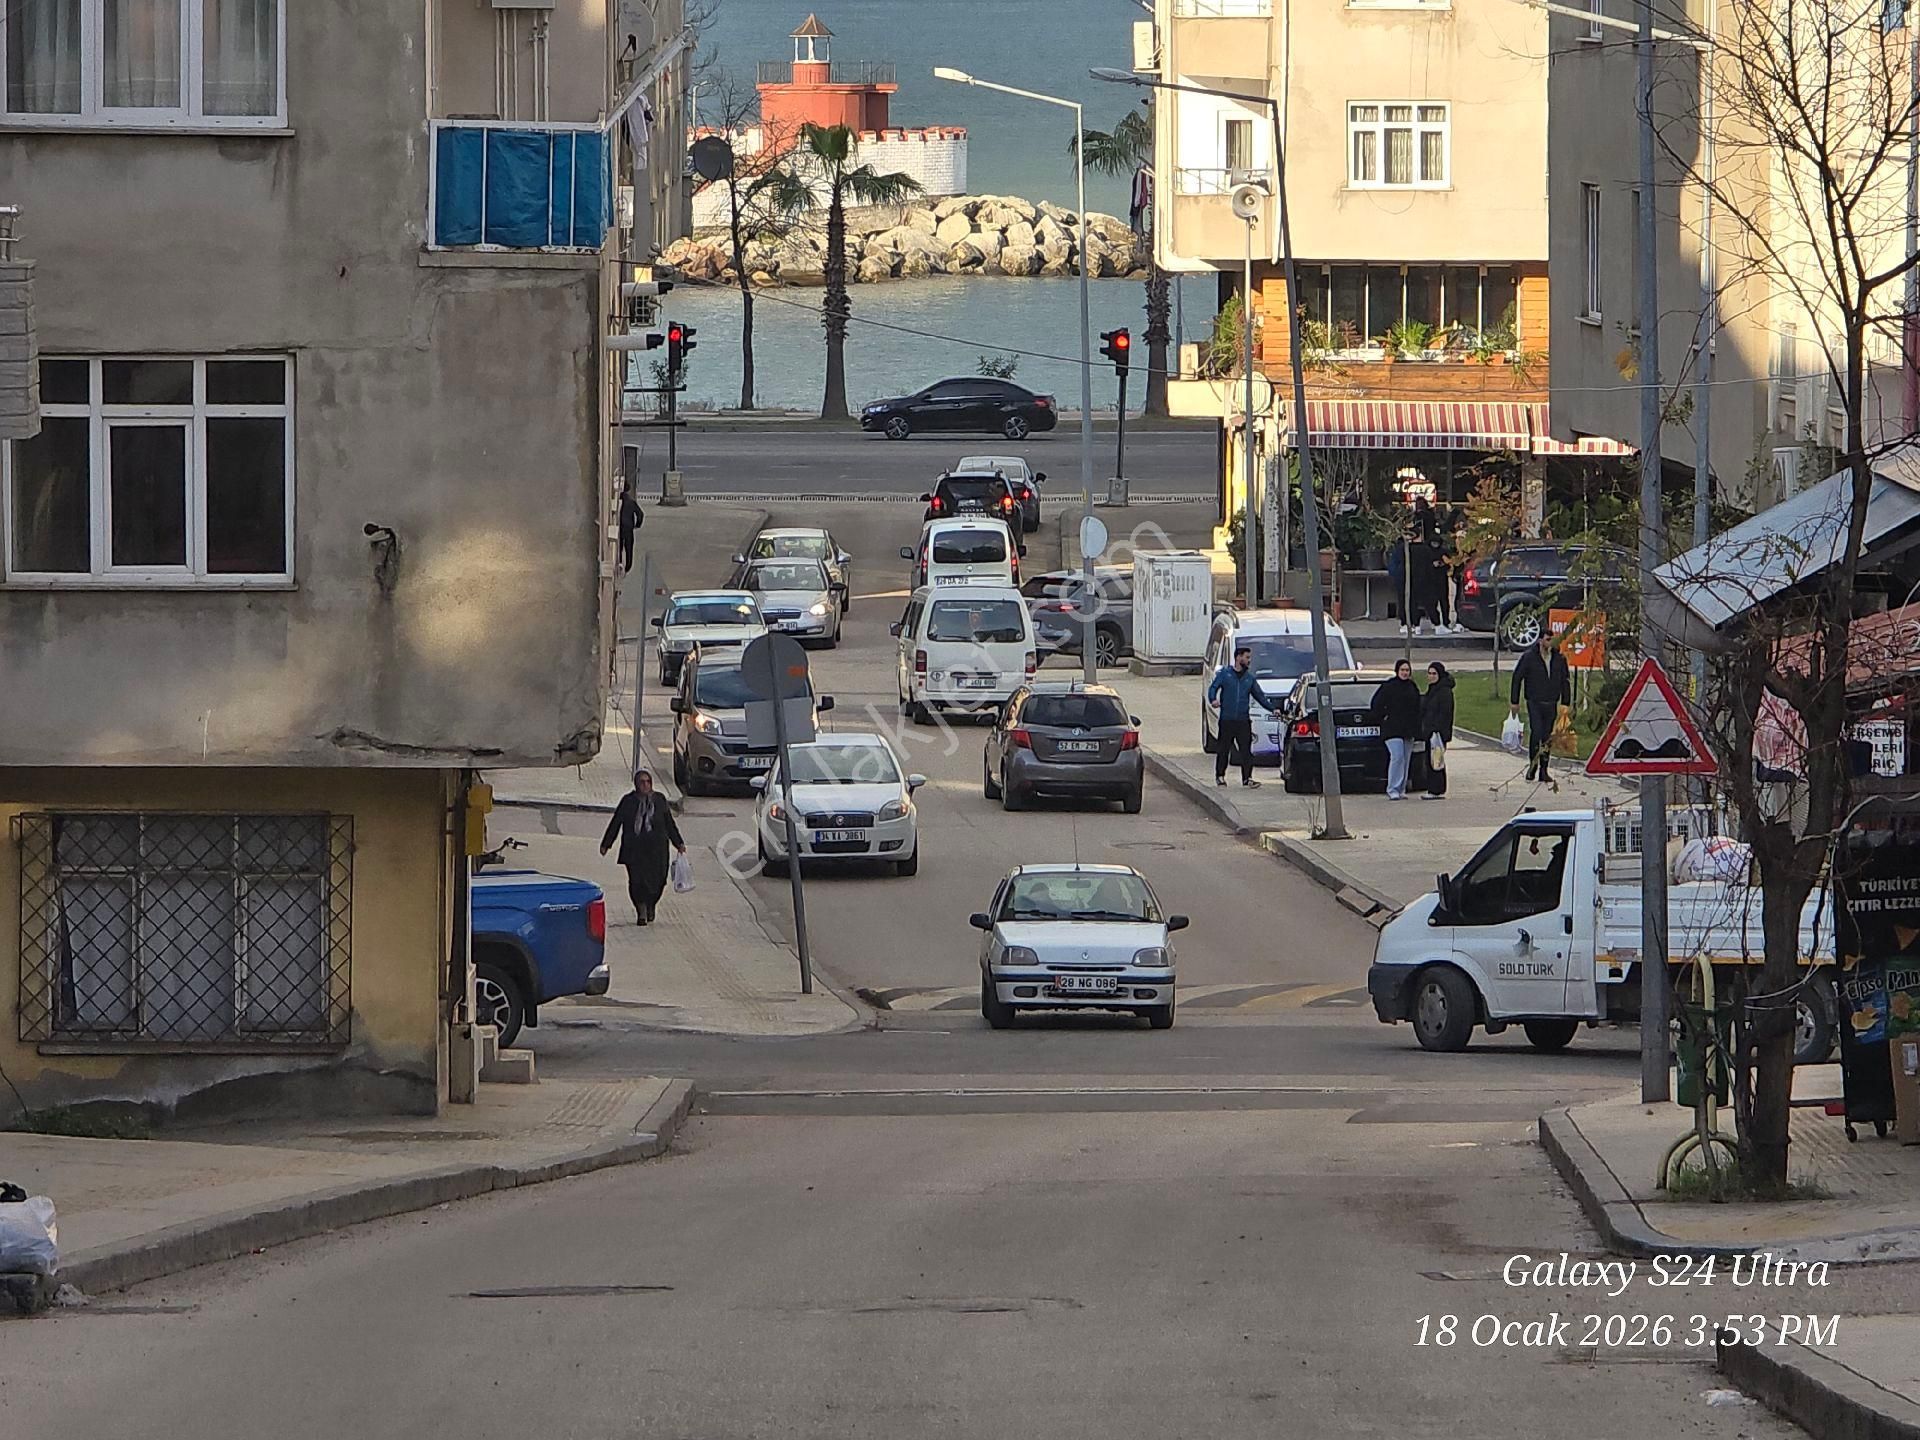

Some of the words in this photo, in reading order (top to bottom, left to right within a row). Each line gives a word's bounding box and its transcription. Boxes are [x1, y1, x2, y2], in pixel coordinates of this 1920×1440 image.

[1526, 963, 1555, 976] TURK
[1061, 978, 1075, 988] 28
[1078, 978, 1092, 988] NG
